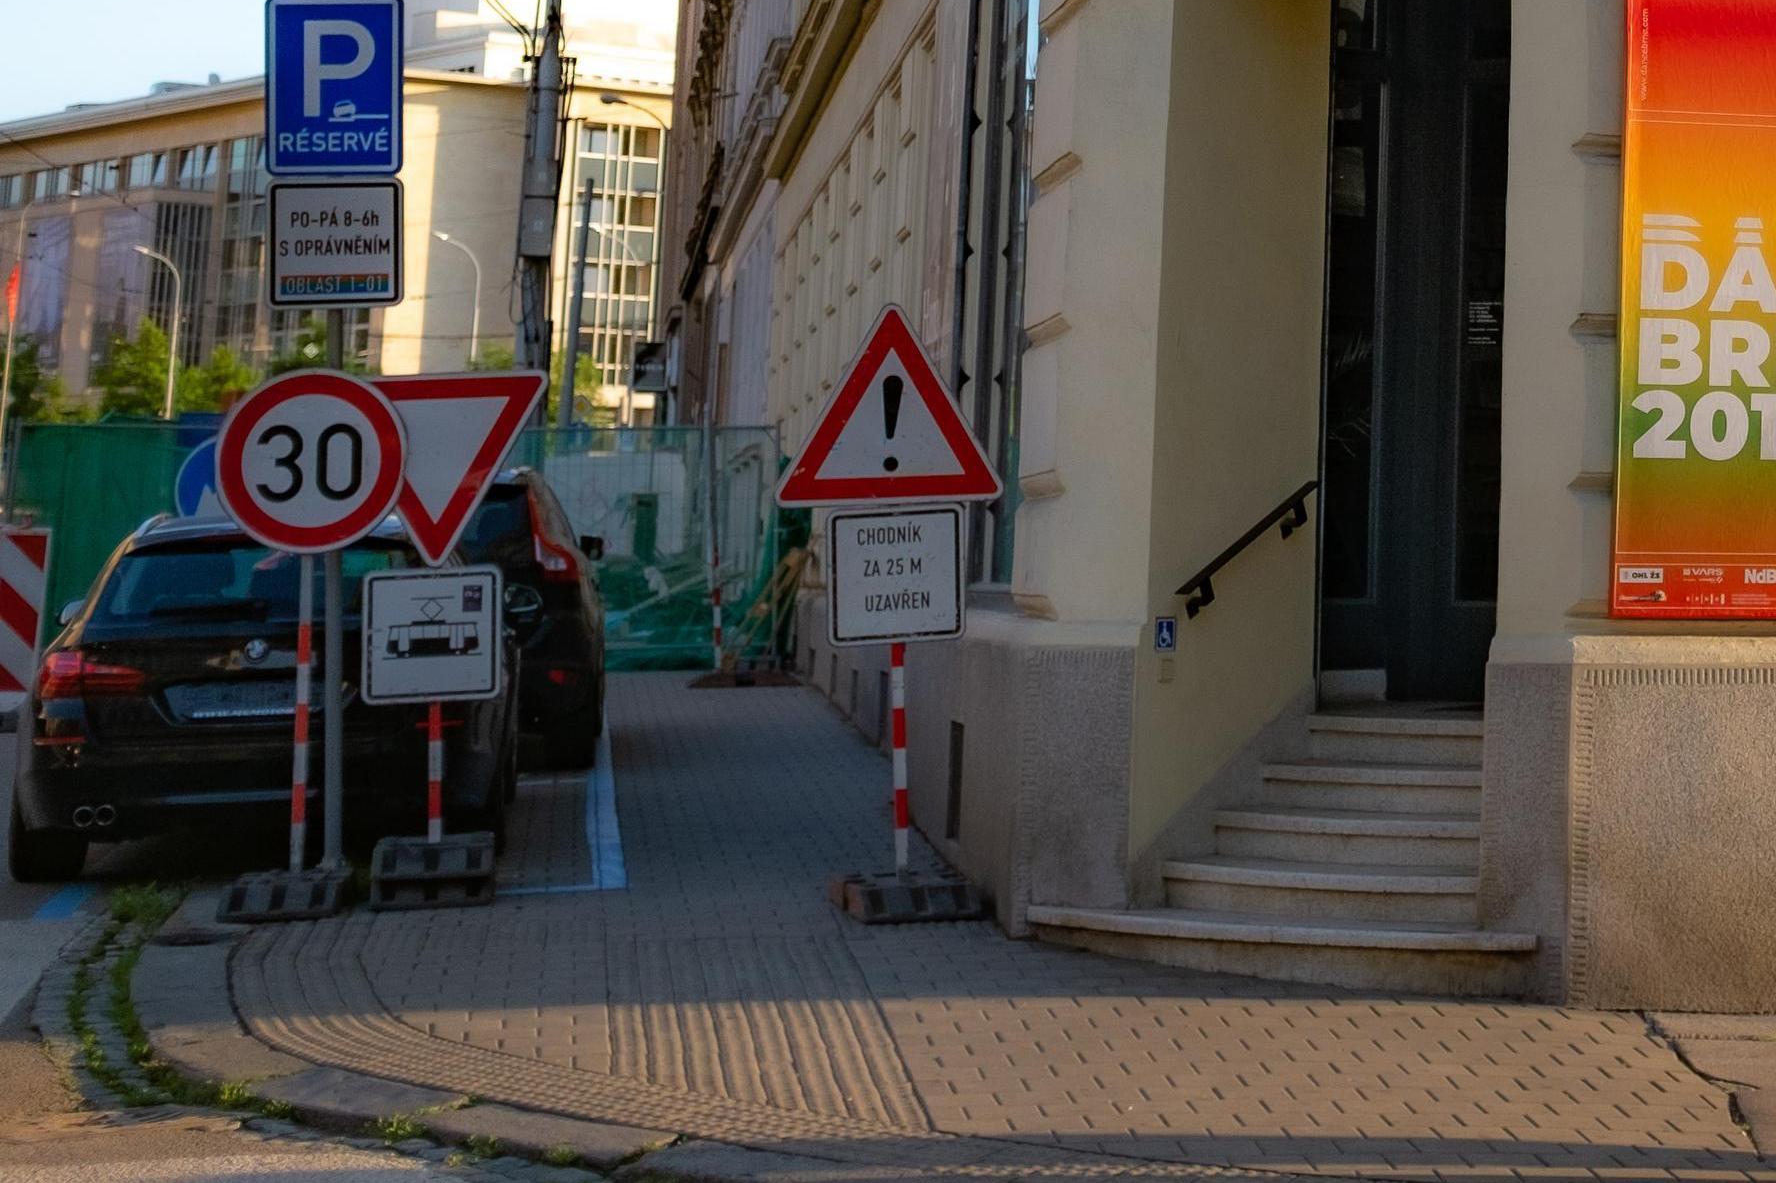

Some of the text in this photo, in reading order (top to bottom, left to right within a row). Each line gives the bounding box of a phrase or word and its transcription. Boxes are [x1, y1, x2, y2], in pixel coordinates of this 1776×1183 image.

[303, 20, 376, 117] P
[279, 127, 389, 155] RÉSERVÉ
[290, 206, 379, 228] PO-PÁ 8-6h
[280, 234, 390, 257] S OPRÁVNĚNÍM
[286, 276, 382, 293] OBLAST 1-01
[256, 423, 363, 502] 30
[857, 521, 921, 546] CHODNÍK
[864, 557, 921, 577] ZA 25 M
[865, 589, 930, 612] UZAVŘEN
